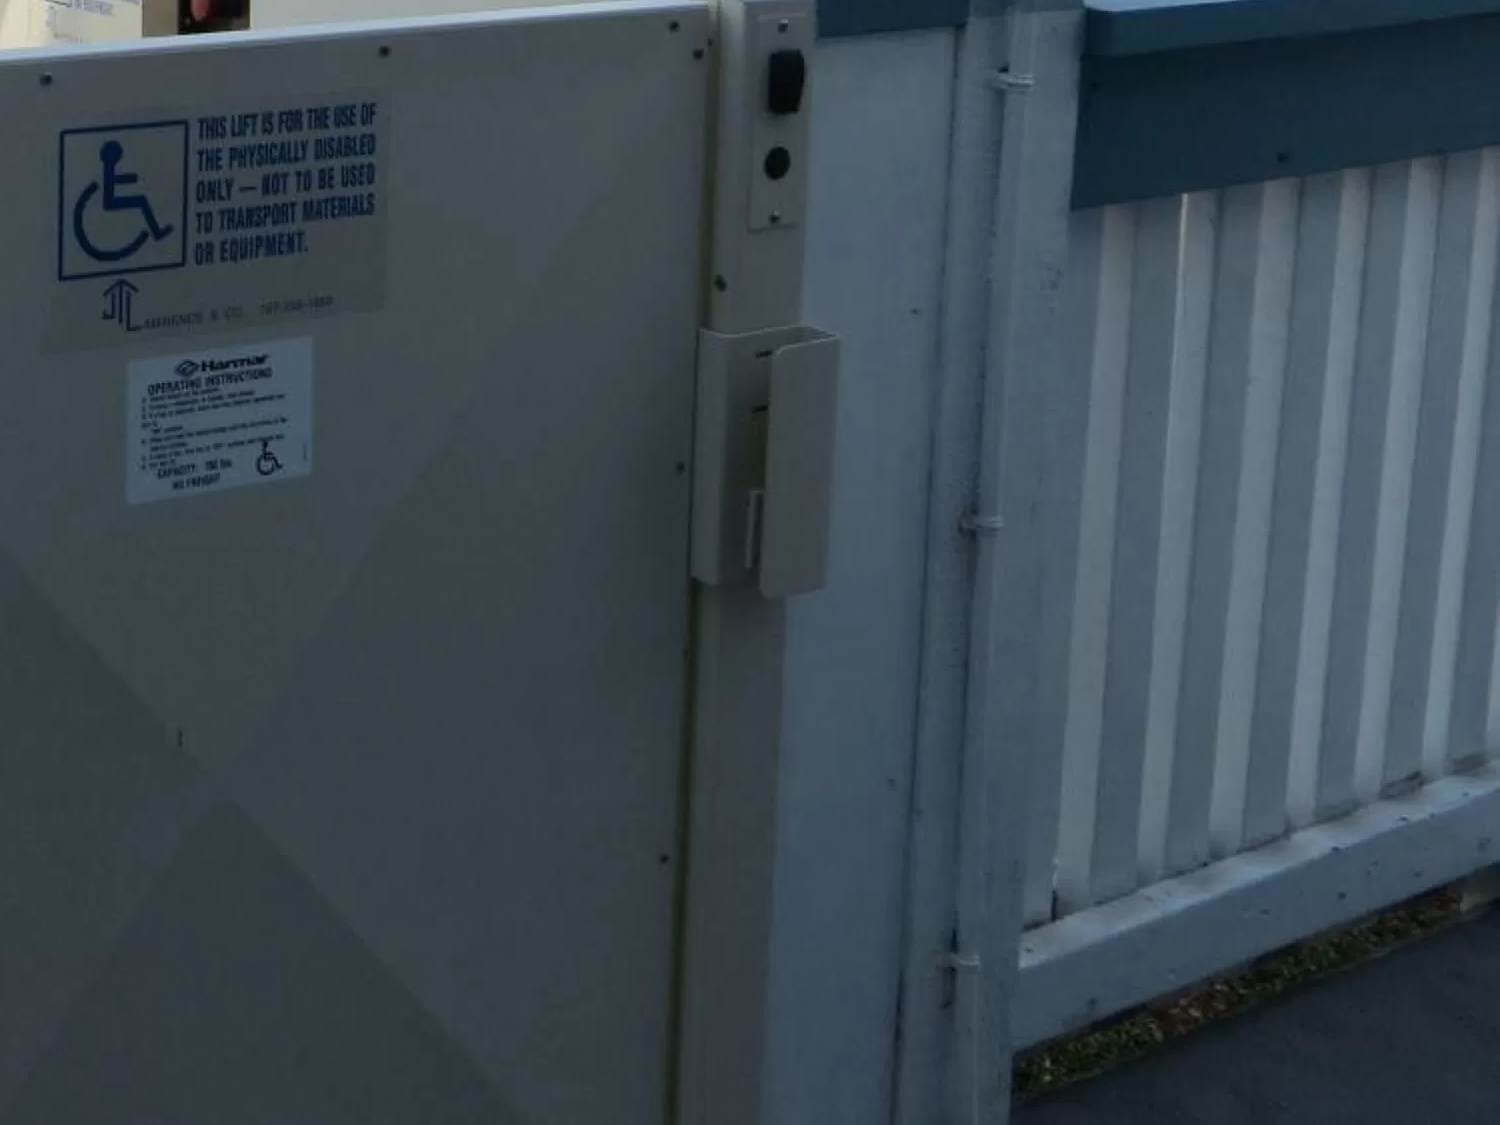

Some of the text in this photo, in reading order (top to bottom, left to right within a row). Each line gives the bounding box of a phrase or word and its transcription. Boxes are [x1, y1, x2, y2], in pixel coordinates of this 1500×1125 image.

[198, 102, 376, 140] THIS LIFT IS FOR THE USE OF
[197, 133, 376, 172] THE PHYSICALLY DISABLED
[196, 177, 234, 203] ONLY
[261, 171, 289, 196] NOT
[296, 168, 312, 193] TO
[318, 166, 335, 190] BE
[341, 161, 376, 188] USED
[196, 192, 376, 234] TO TRANSPORT MATERIALS
[195, 231, 308, 265] OR EQUIPMENT.
[204, 367, 273, 386] INSTRUCTIONS
